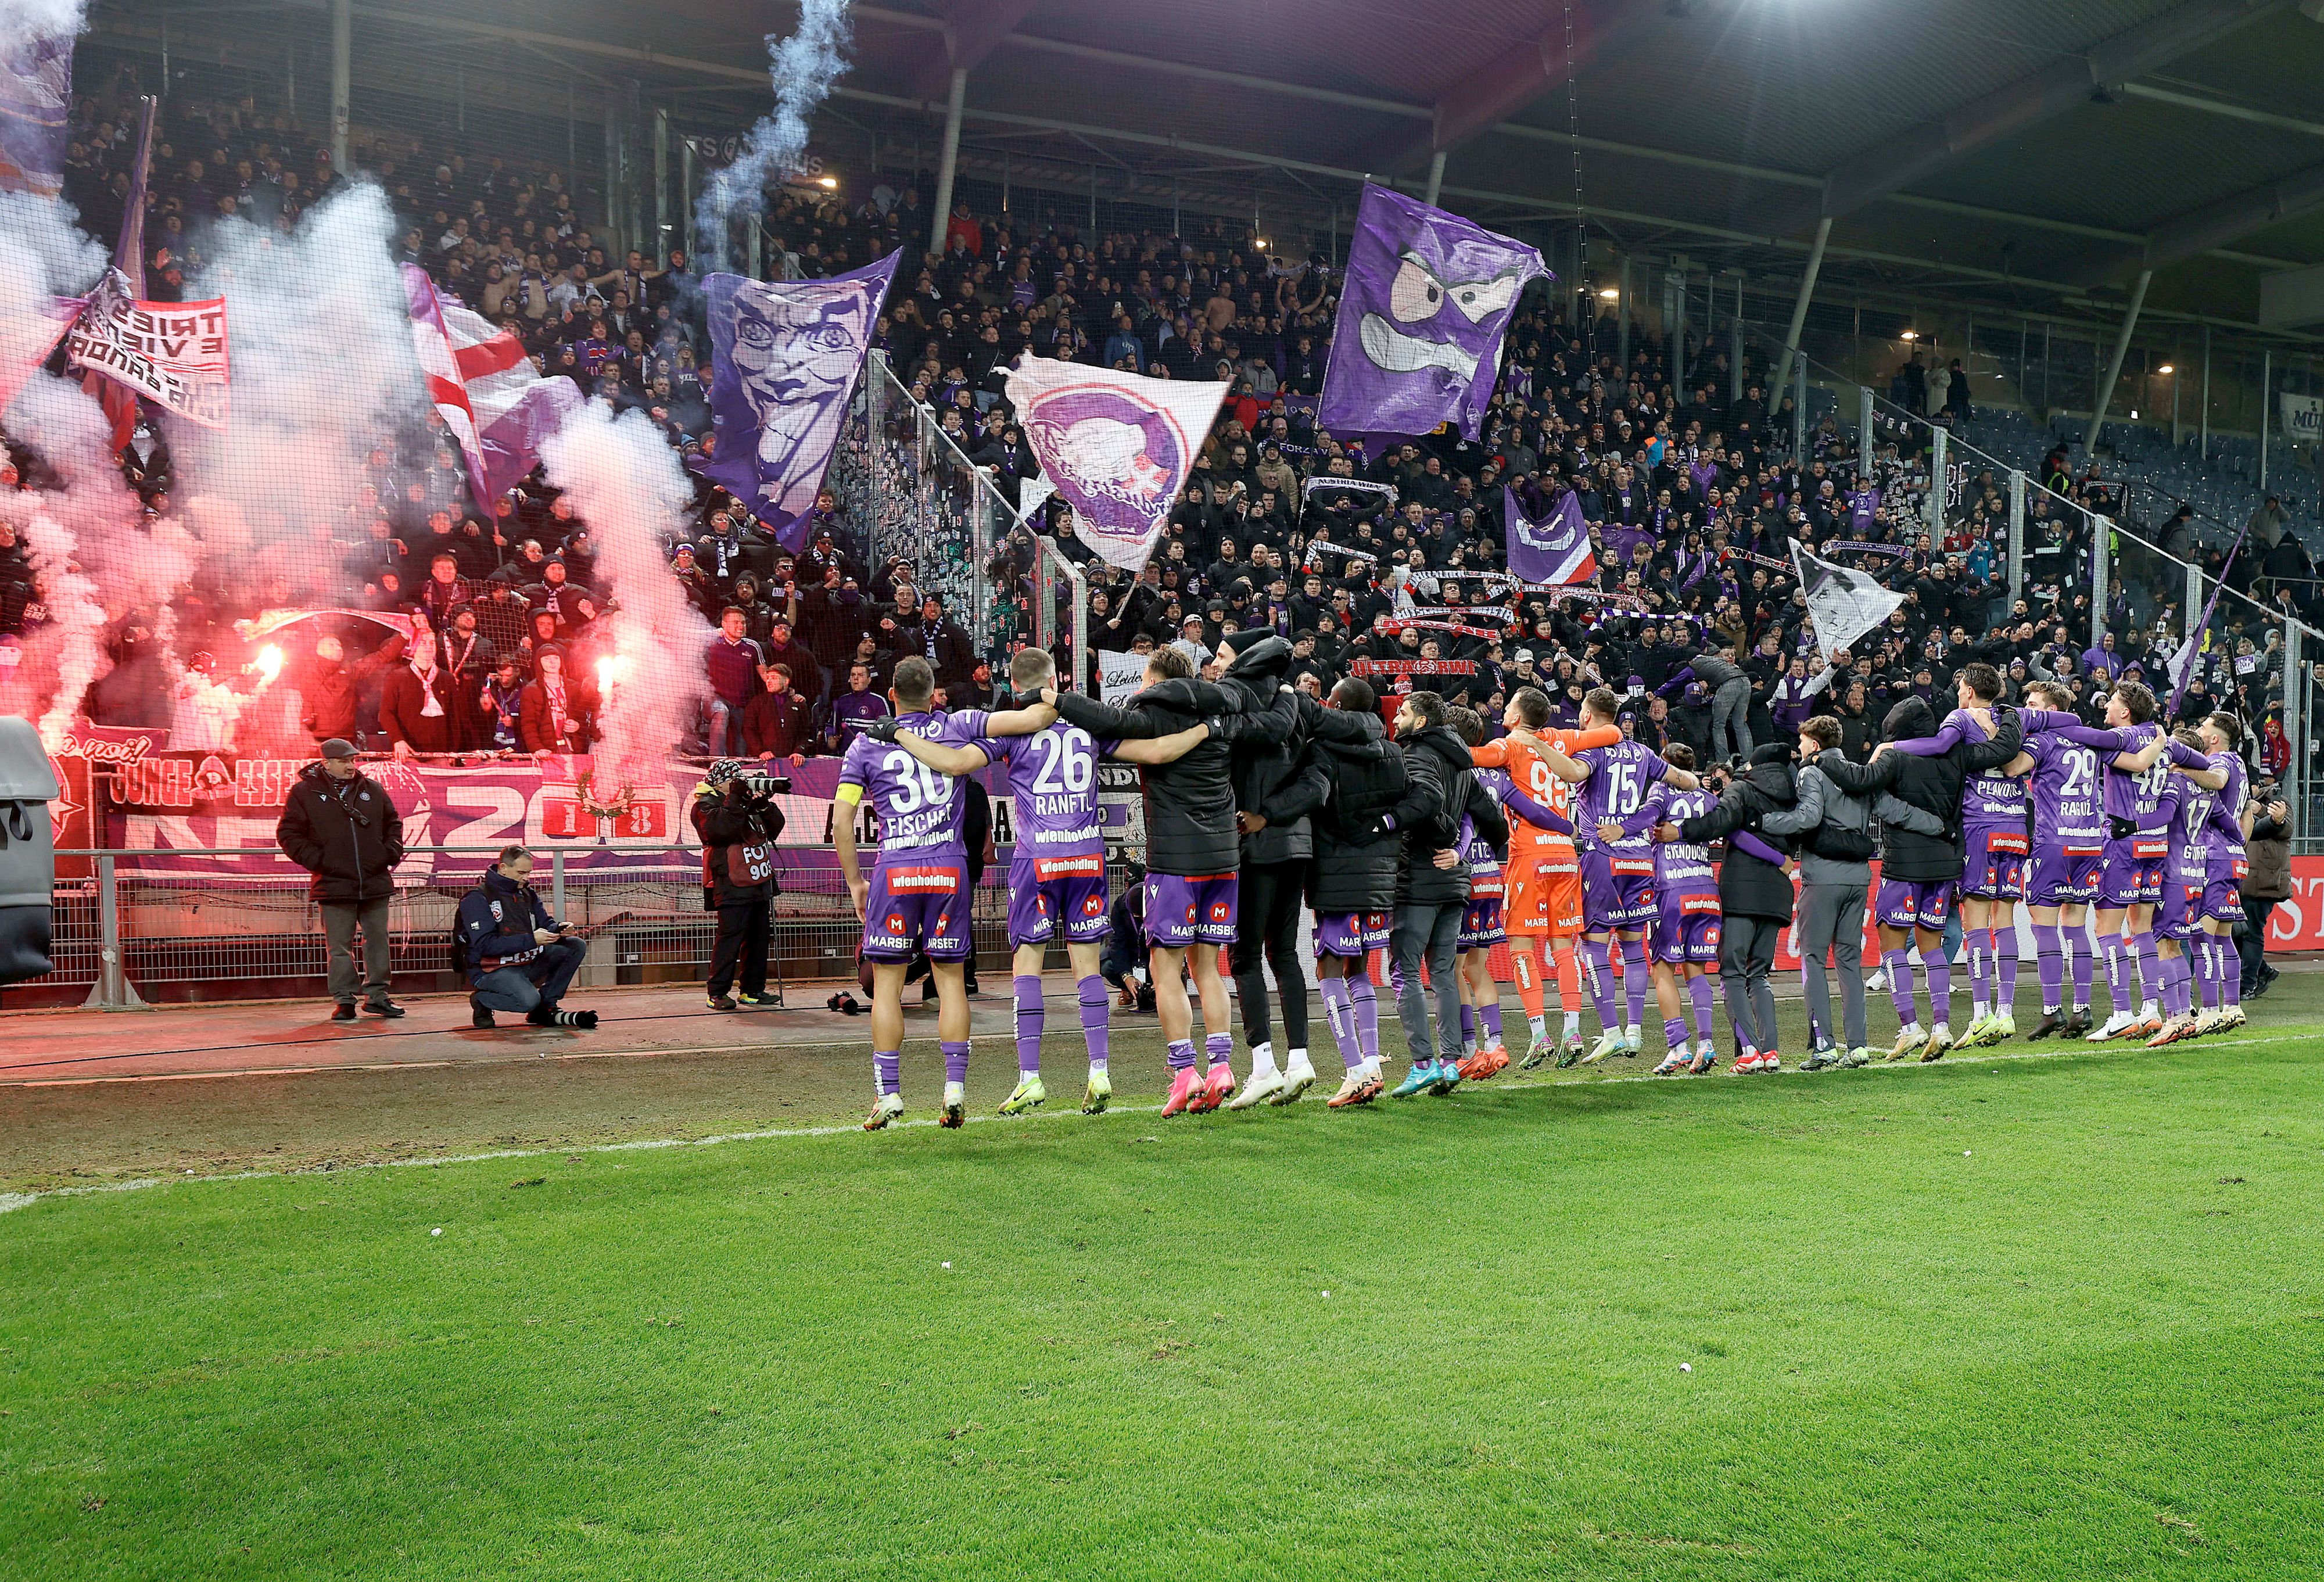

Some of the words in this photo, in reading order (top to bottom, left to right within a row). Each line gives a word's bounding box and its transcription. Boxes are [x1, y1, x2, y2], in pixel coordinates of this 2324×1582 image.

[1318, 478, 1357, 487] AUSTRIA
[1351, 660, 1415, 676] ULTRA
[1031, 728, 1092, 794] 26
[2060, 747, 2096, 797] 29
[883, 749, 954, 813] 30
[1530, 760, 1569, 809] 99
[1606, 761, 1640, 815] 15
[1036, 792, 1093, 815] RANFTL
[886, 803, 954, 837] FISCHER
[2186, 799, 2211, 844] 17
[743, 842, 769, 864] FOT
[1040, 859, 1099, 874] wienholding
[1537, 863, 1579, 874] wienholding
[1615, 861, 1653, 871] wienholding
[892, 874, 956, 888] wienholding
[2151, 874, 2158, 883] M
[1086, 901, 1098, 912] M
[1214, 907, 1225, 917] M
[1628, 904, 1658, 918] MARSB
[1371, 915, 1380, 925] M
[1524, 917, 1548, 927] MARS
[1891, 911, 1917, 921] MARS
[891, 919, 902, 930] M
[936, 919, 947, 930] M
[1477, 927, 1504, 941] MARSB
[1707, 931, 1716, 941] M
[1691, 945, 1717, 955] MARS
[2107, 945, 2119, 986] wienholding
[1585, 953, 1602, 998] wienholding
